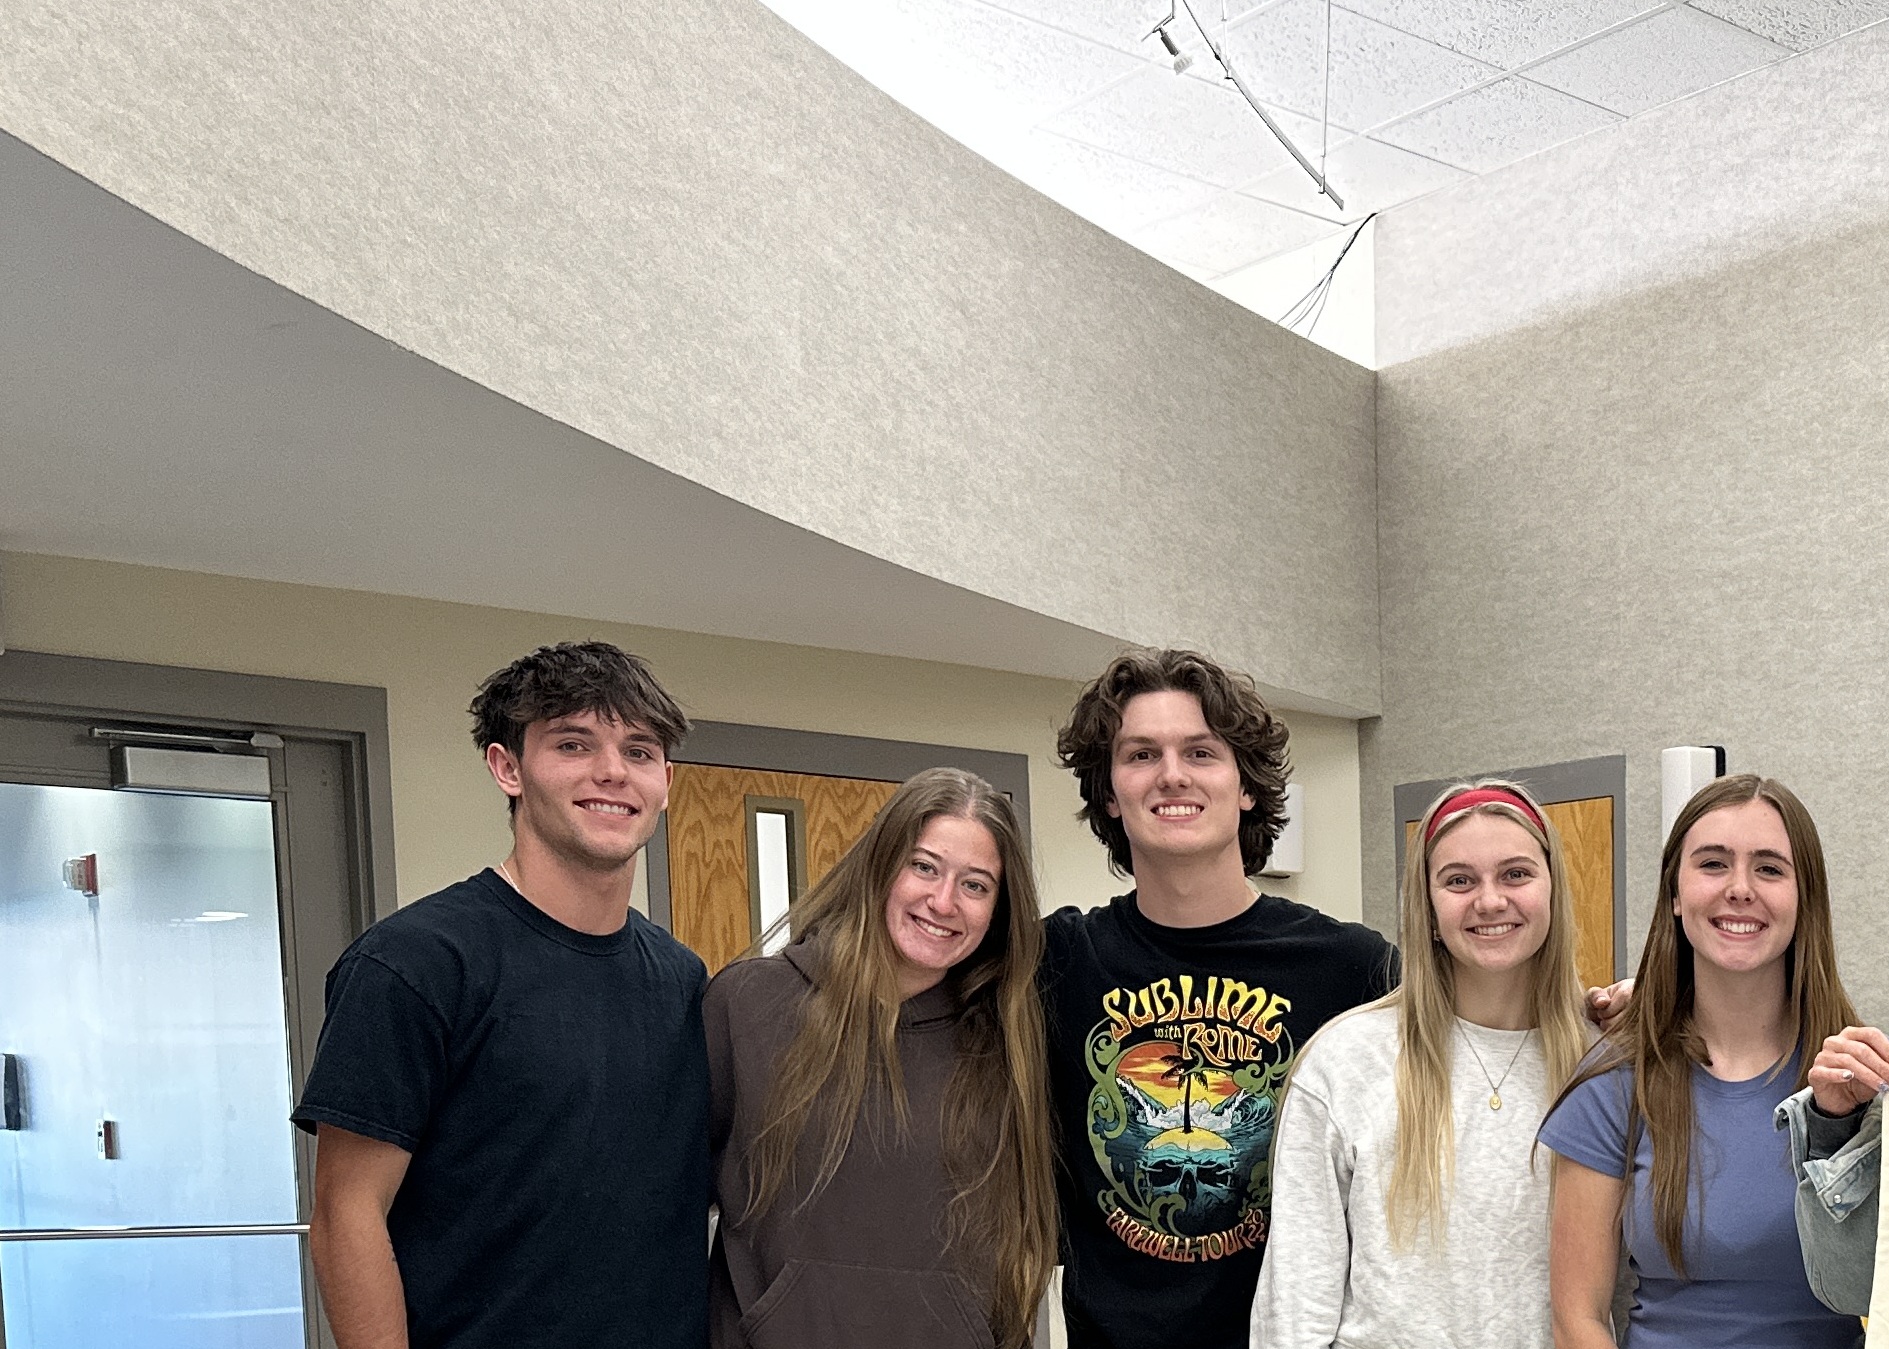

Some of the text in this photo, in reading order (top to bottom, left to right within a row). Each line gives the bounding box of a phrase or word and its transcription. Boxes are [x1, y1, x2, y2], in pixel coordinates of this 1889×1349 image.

[1102, 974, 1292, 1044] SUBLIME
[1153, 1021, 1263, 1067] with ROME
[1105, 1206, 1256, 1263] FAREWELL TOUR
[1243, 1208, 1264, 1225] 20
[1247, 1222, 1266, 1243] 24
